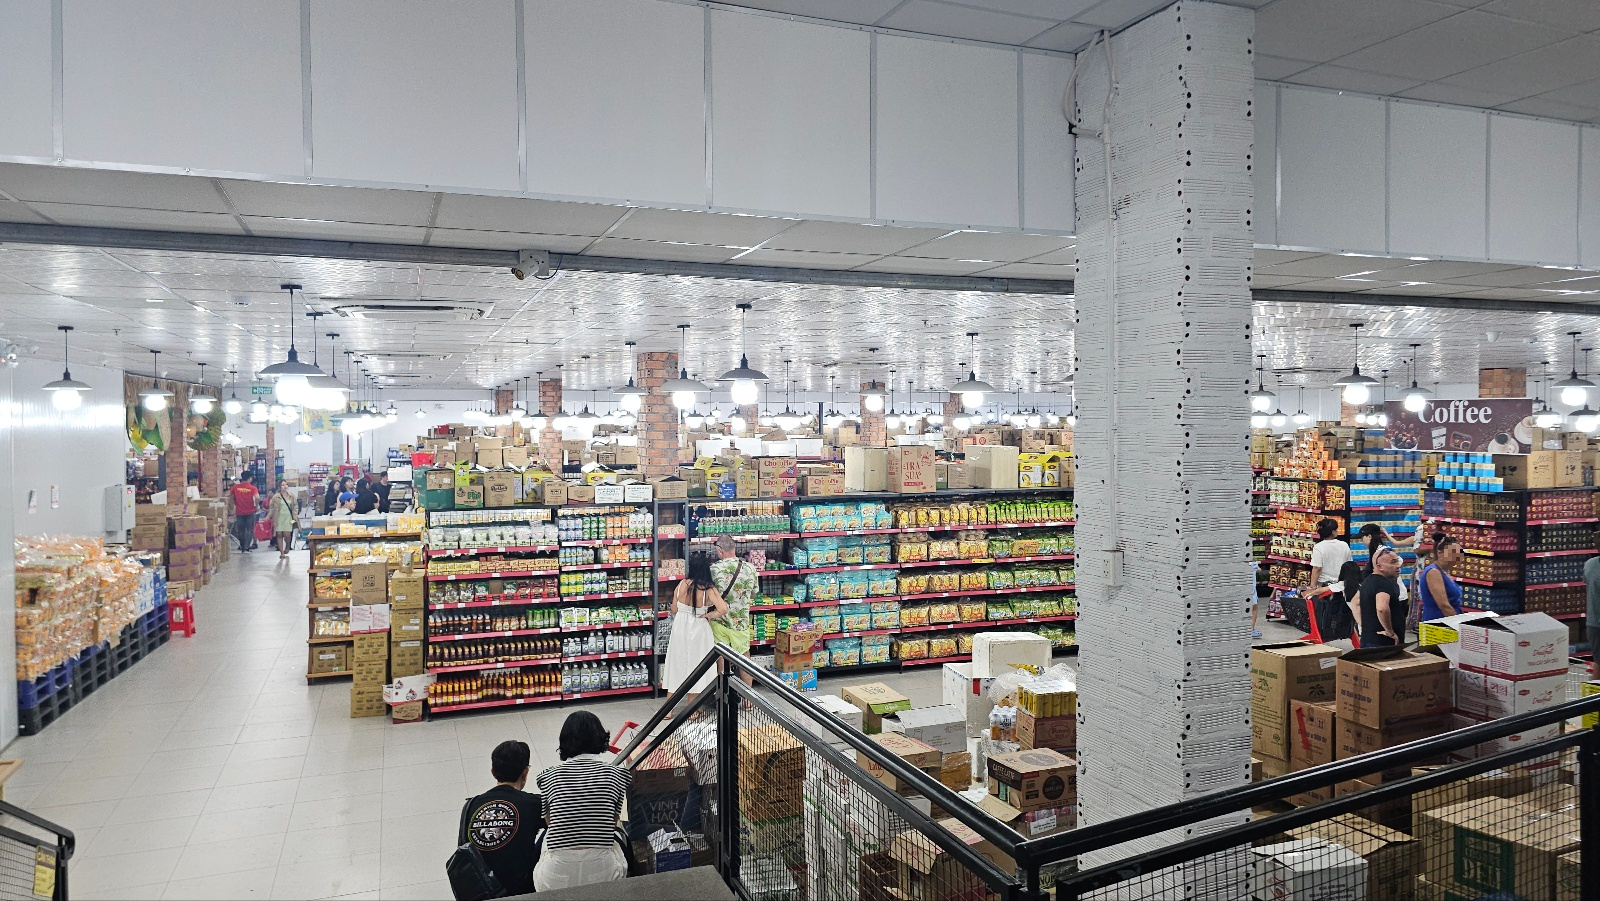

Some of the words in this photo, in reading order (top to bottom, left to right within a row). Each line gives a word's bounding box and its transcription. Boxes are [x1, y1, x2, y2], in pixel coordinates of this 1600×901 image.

[1416, 400, 1493, 424] Coffee
[497, 803, 515, 816] QUALITY
[472, 820, 514, 828] BILLABONG
